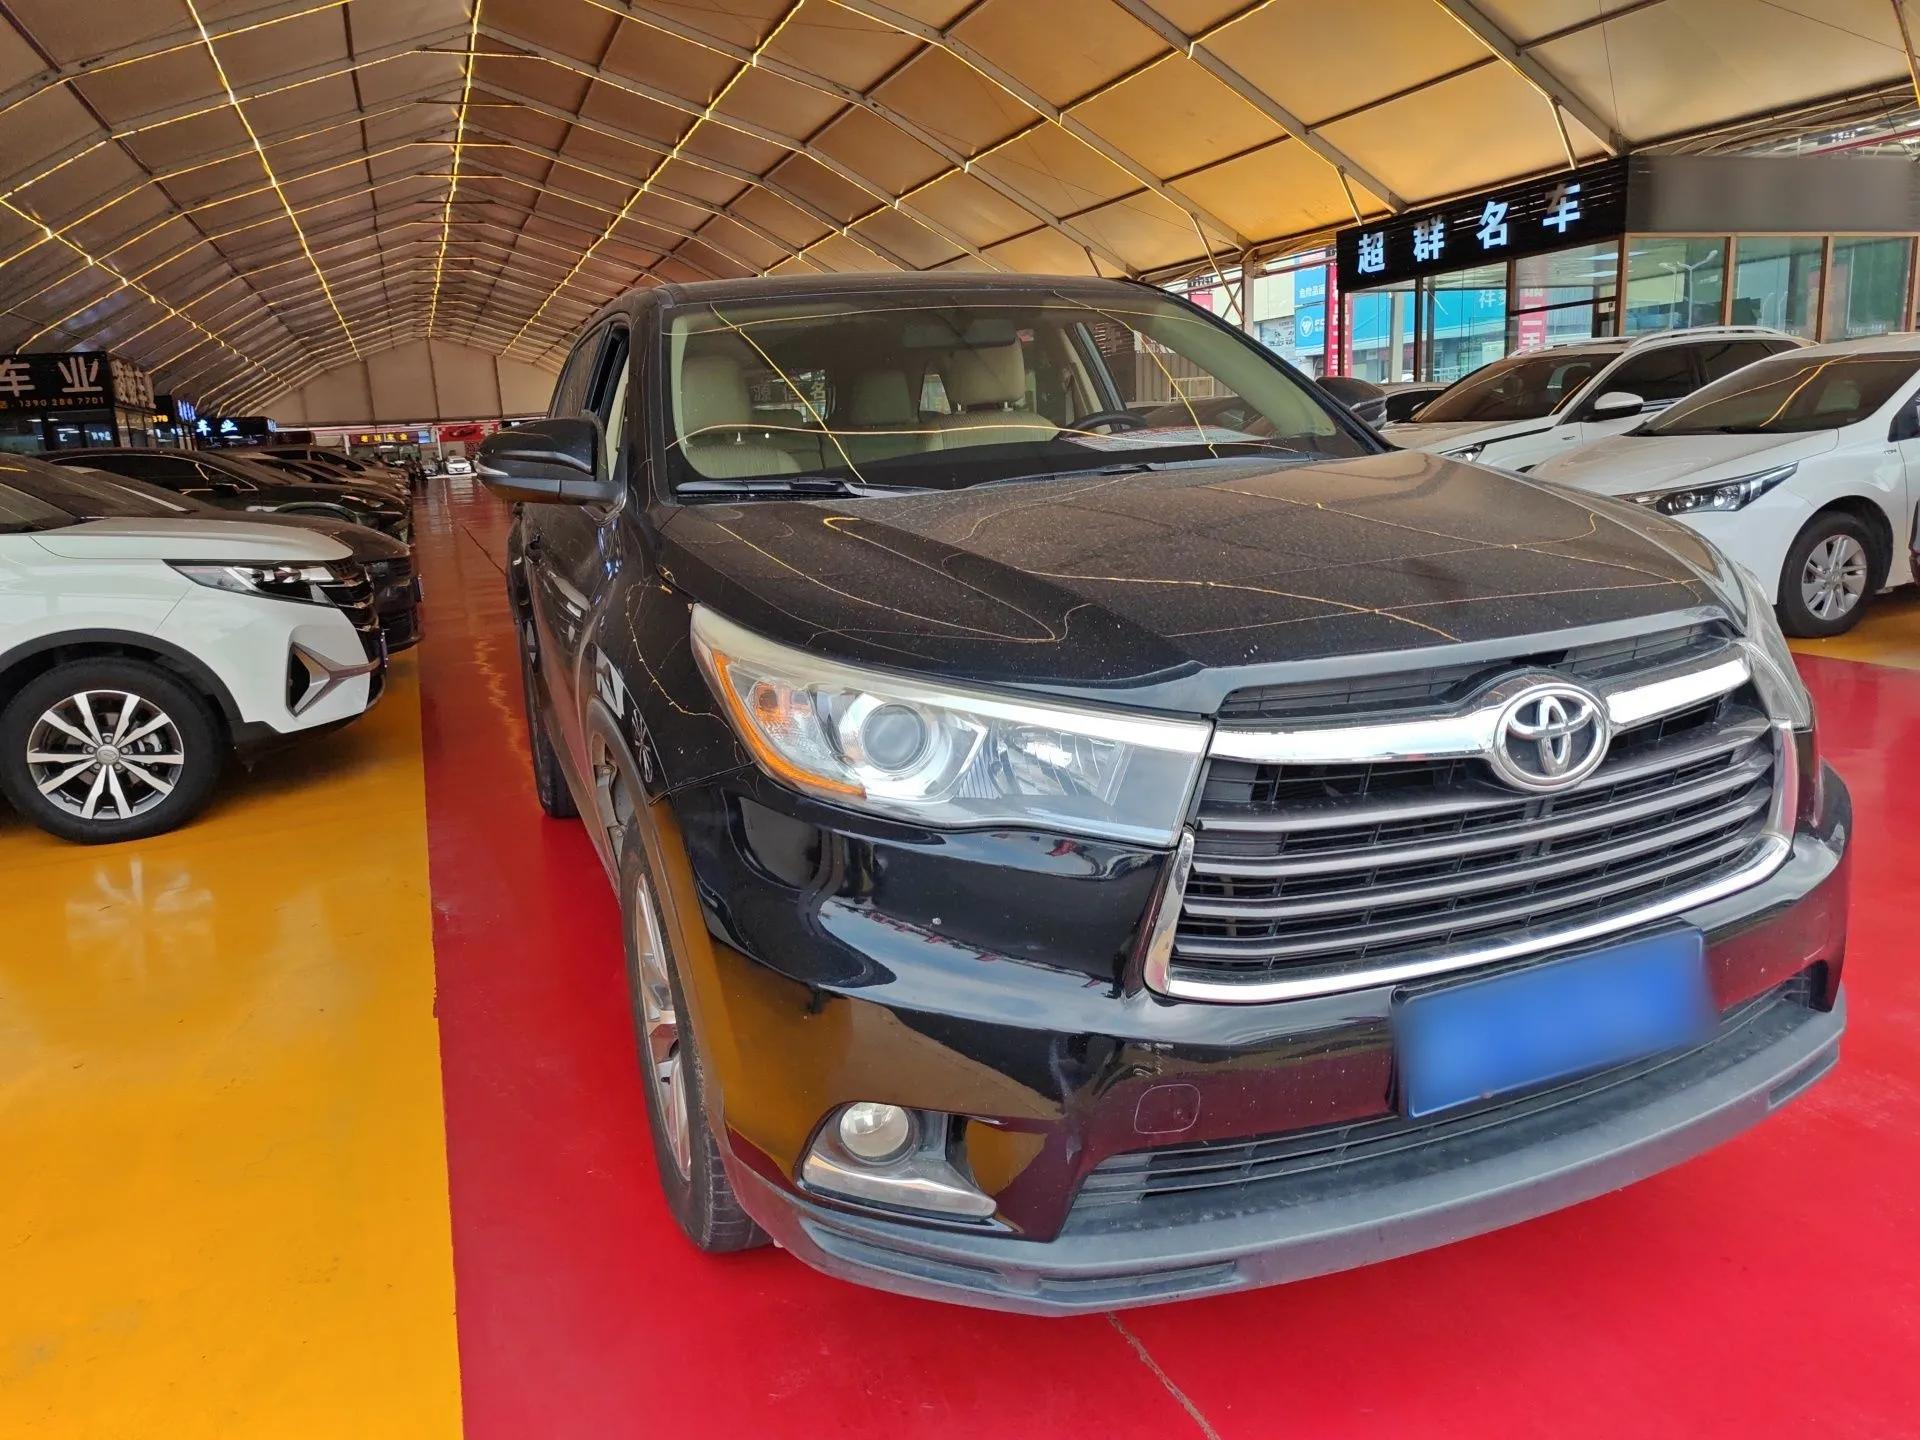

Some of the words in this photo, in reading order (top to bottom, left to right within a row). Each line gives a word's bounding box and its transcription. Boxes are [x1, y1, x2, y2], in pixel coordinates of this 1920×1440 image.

[1357, 183, 1581, 275] 超群名车
[0, 356, 104, 397] 车业
